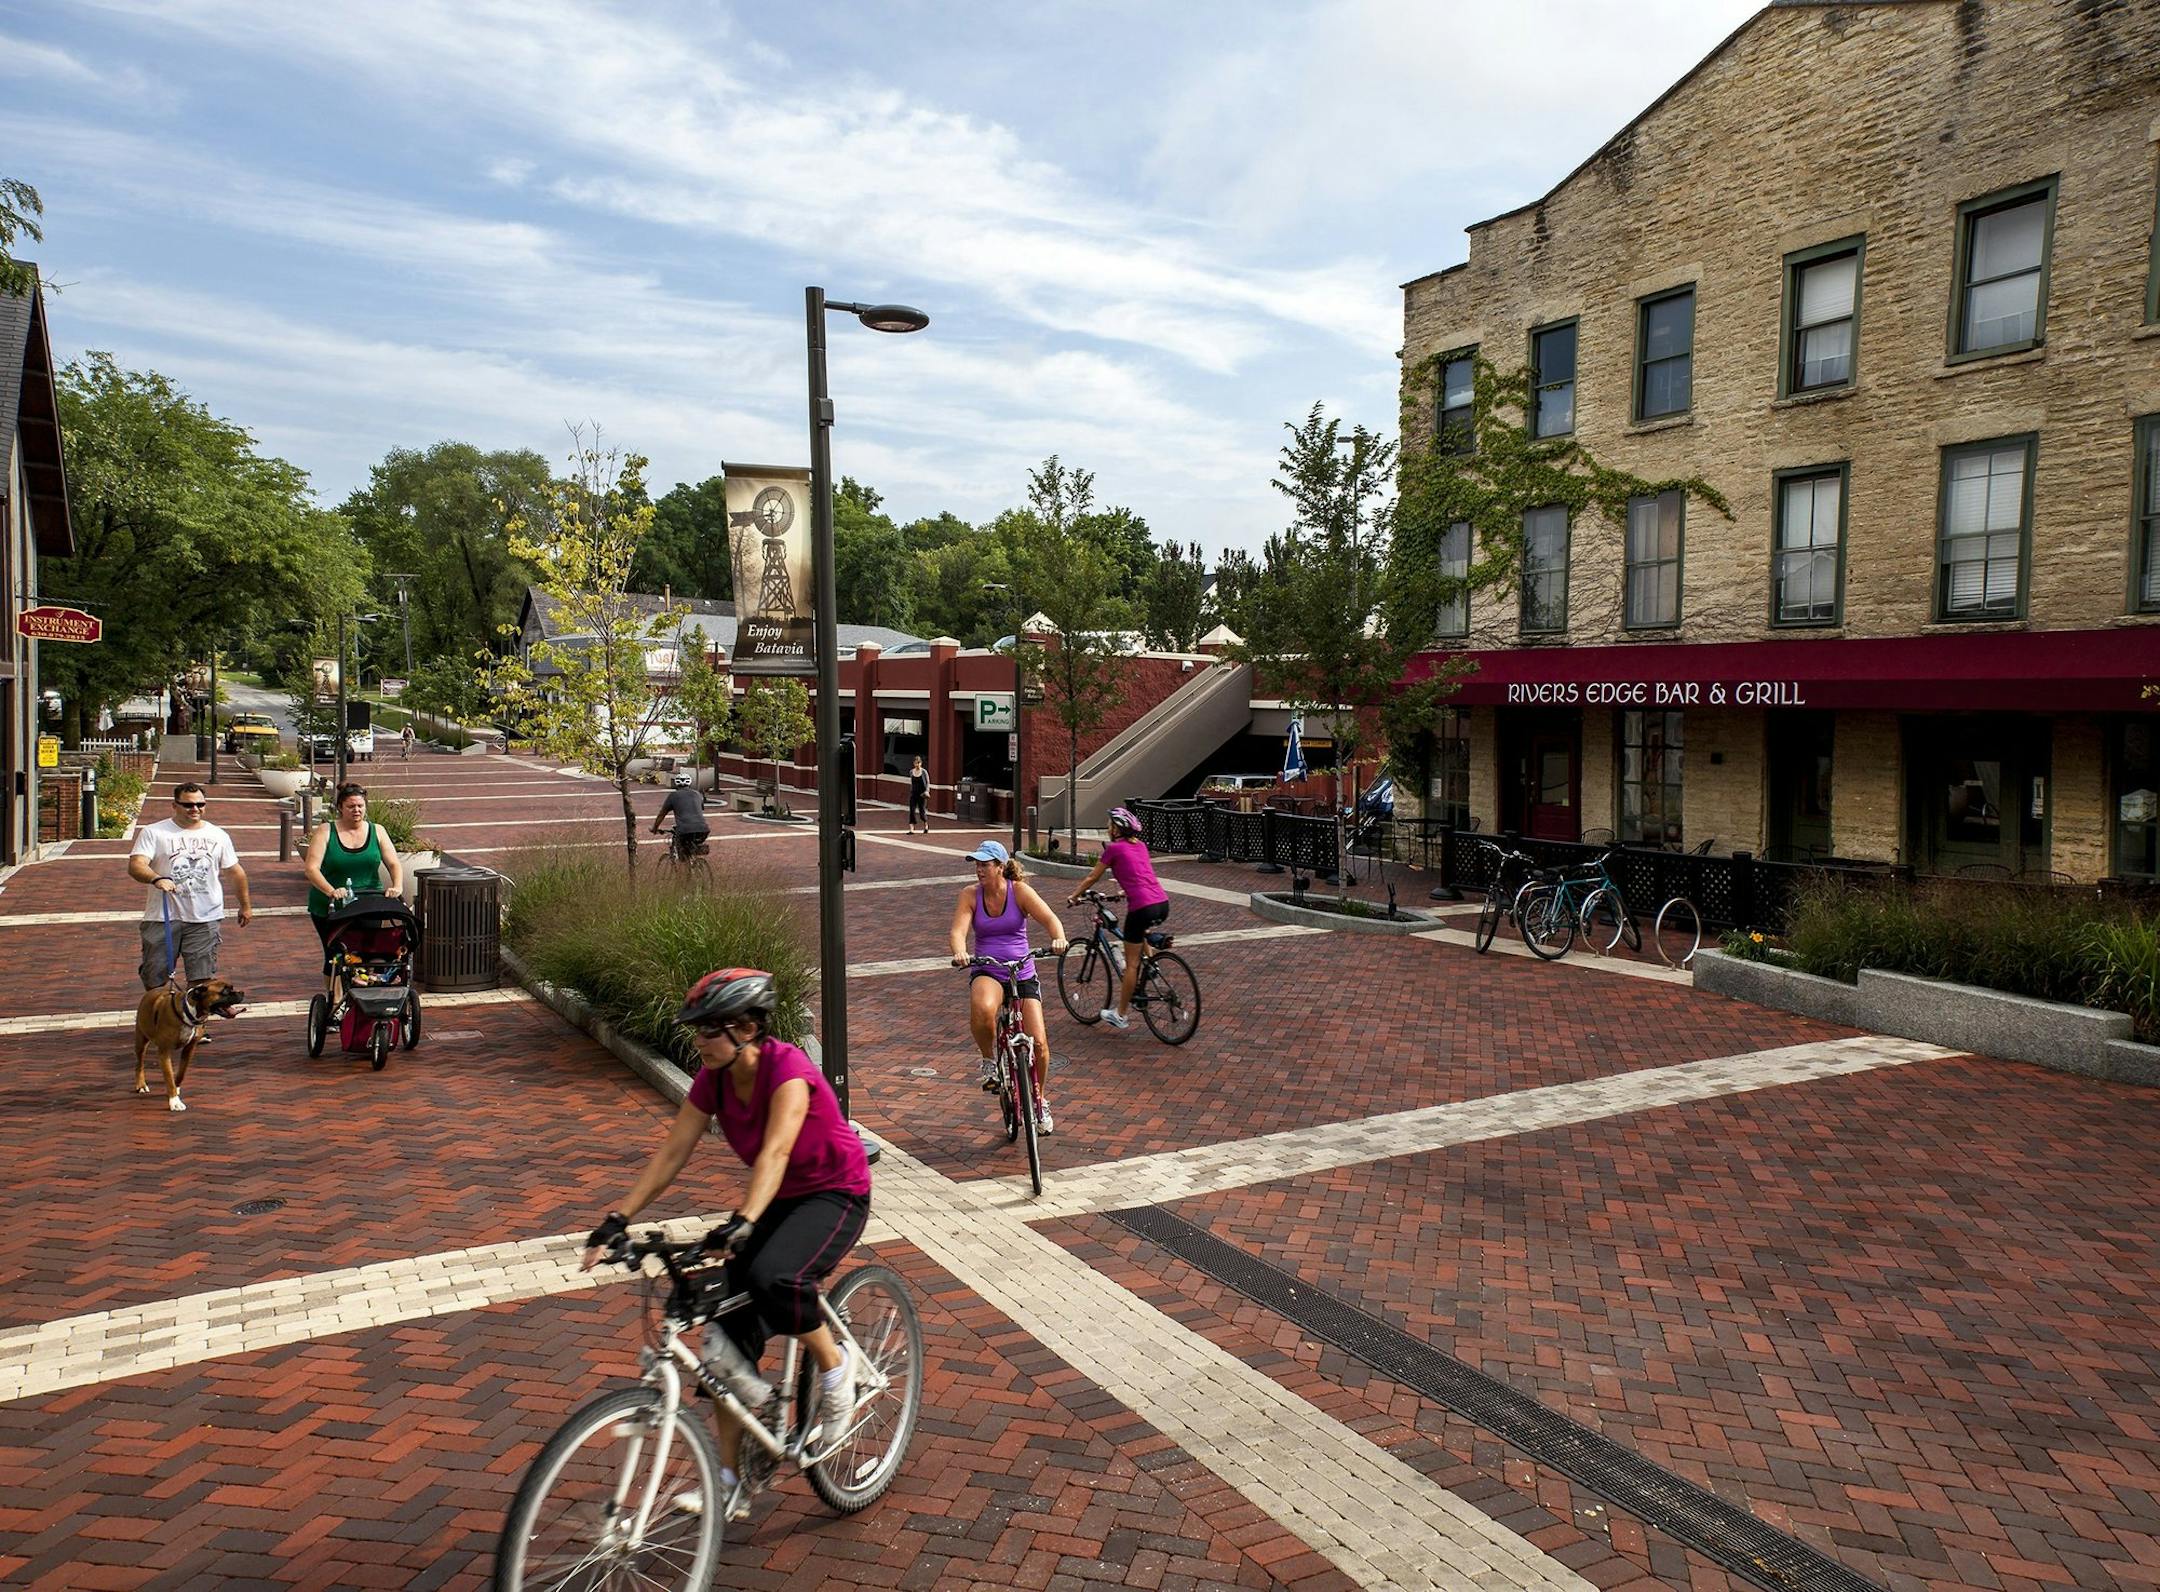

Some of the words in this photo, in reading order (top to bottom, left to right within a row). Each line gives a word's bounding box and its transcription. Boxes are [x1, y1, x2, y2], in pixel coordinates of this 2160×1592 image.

[24, 614, 95, 628] INSTRUMENT
[30, 623, 90, 635] EXCHANGE
[747, 624, 782, 640] Enjoy
[755, 642, 804, 655] Batavia
[1508, 683, 1579, 703] RIVERS
[1586, 682, 1648, 704] EDGE
[1655, 682, 1700, 704] BAR
[1709, 682, 1726, 705] &
[1735, 681, 1806, 705] GRILL
